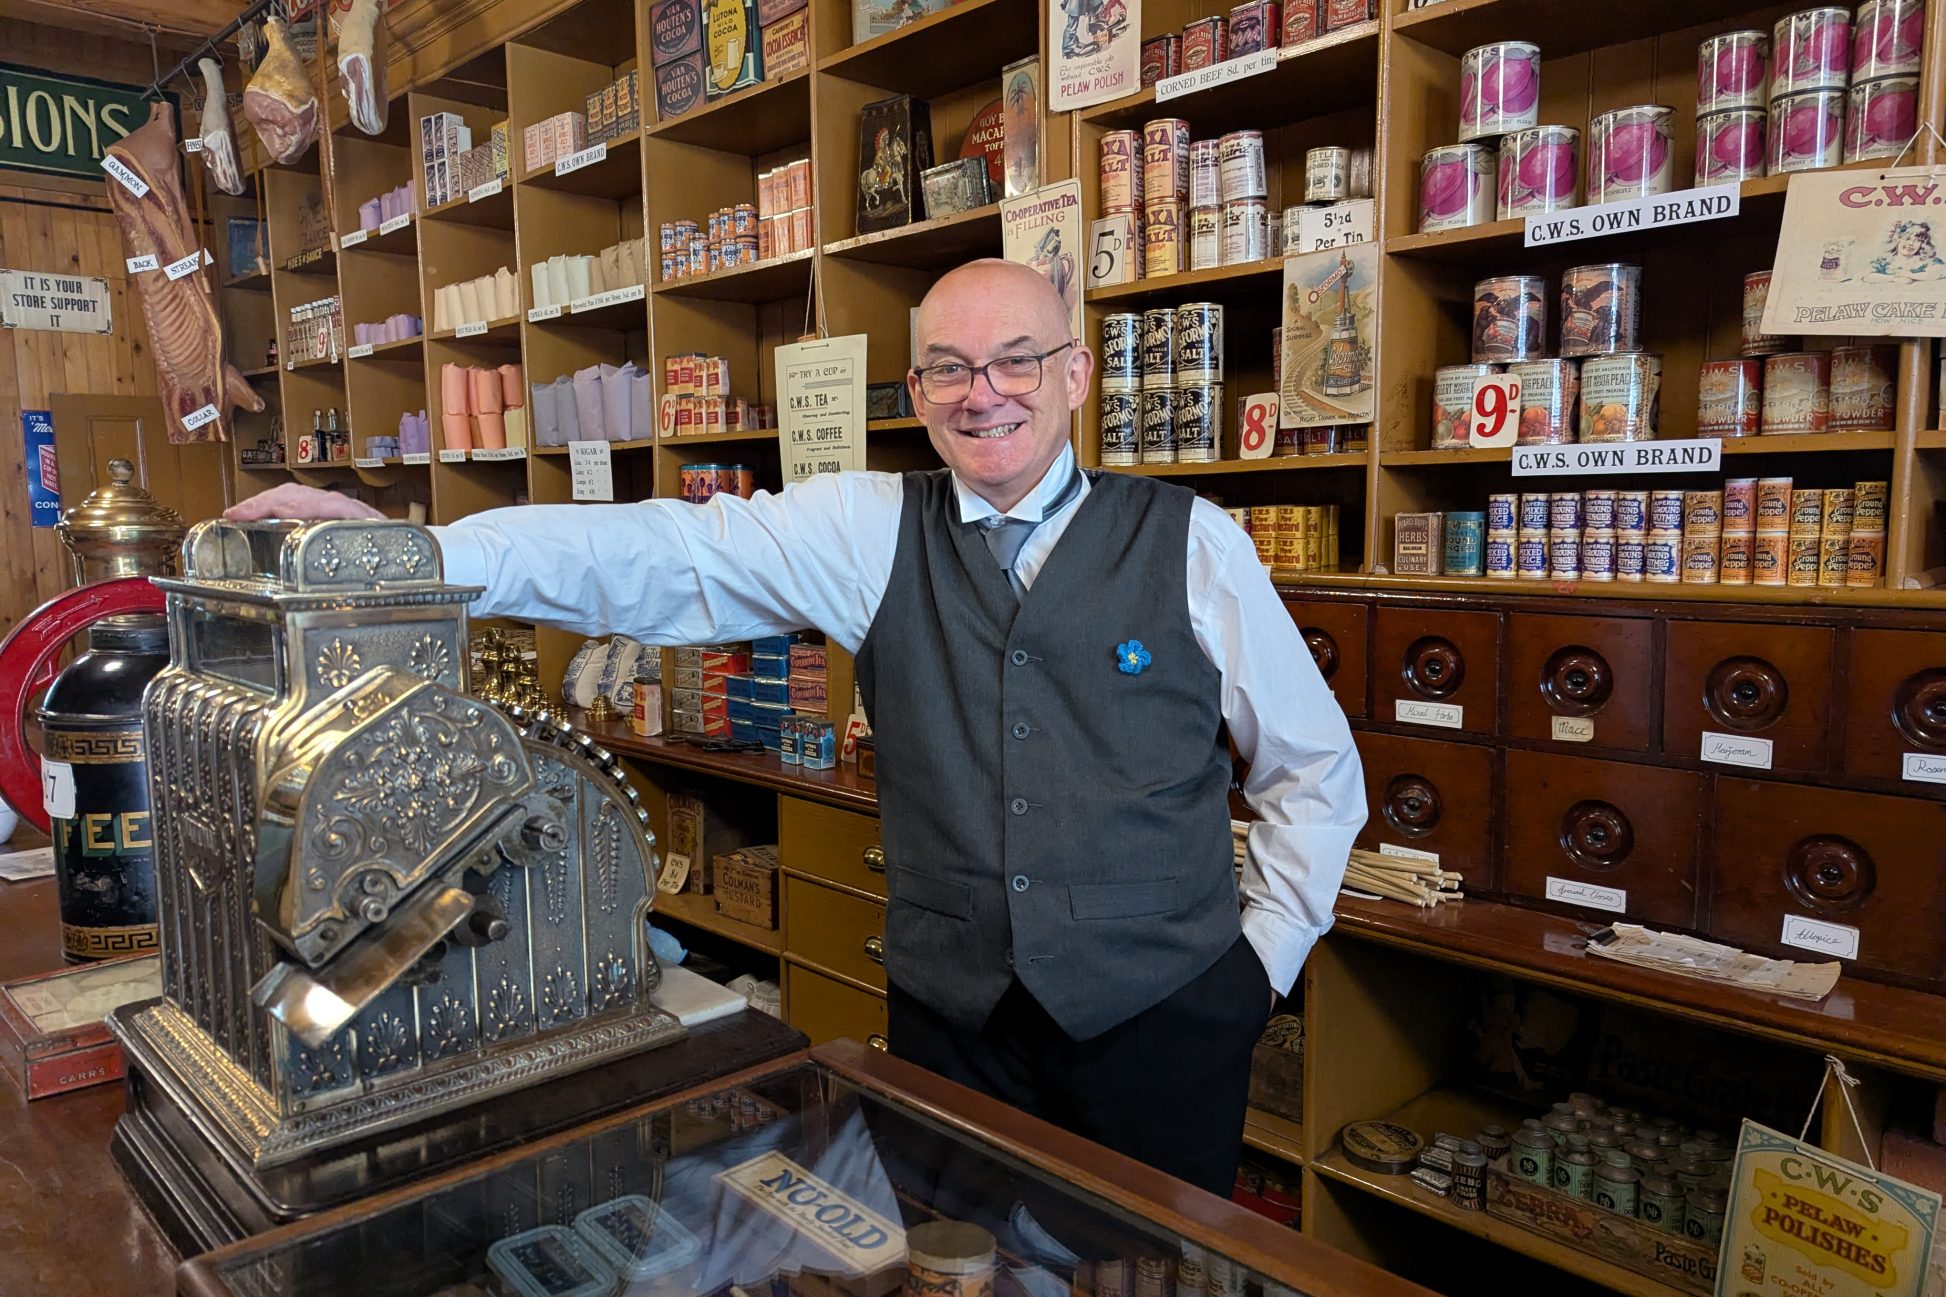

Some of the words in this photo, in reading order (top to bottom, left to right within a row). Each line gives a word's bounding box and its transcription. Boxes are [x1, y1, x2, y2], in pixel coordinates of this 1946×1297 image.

[667, 2, 680, 16] VAN
[713, 7, 738, 23] LUTONA
[656, 9, 691, 35] HOUTEN'S
[661, 26, 686, 43] COCOA
[713, 24, 738, 39] COCOA
[670, 65, 685, 78] VAN
[1160, 75, 1196, 96] CORNED
[1200, 68, 1223, 85] BEEF
[1243, 60, 1257, 75] per
[661, 71, 697, 96] HOUTEN'S
[1061, 80, 1091, 98] PELAW
[1094, 71, 1124, 91] POLISH
[667, 89, 692, 104] COCOA
[0, 84, 130, 161] IONS
[1144, 128, 1172, 147] AXA
[586, 148, 605, 162] BRAND
[1101, 139, 1129, 156] AXA
[1144, 149, 1172, 165] ALT
[1101, 159, 1130, 175] ALT
[107, 159, 144, 194] GAMMON
[1060, 194, 1078, 208] TEA
[1838, 184, 1946, 208] C.W.
[1015, 211, 1066, 240] FILLING
[1146, 208, 1178, 227] AXA
[1531, 223, 1584, 243] C.W.S.
[1591, 208, 1642, 232] OWN
[1651, 195, 1732, 226] BRAND
[1145, 228, 1176, 244] ALT
[1315, 237, 1336, 250] Per
[1343, 231, 1363, 244] Tin
[307, 248, 323, 263] SAUCE
[133, 259, 153, 270] BACK
[170, 257, 200, 276] STREAK
[24, 277, 35, 290] IT
[40, 278, 51, 291] IS
[53, 279, 83, 294] YOUR
[12, 294, 46, 308] STORE
[50, 297, 98, 313] SUPPORT
[50, 314, 61, 328] IT
[1793, 302, 1870, 323] PELAW
[1871, 302, 1937, 318] CAKE
[800, 369, 812, 379] TRY
[815, 368, 821, 377] A
[823, 366, 838, 377] CUP
[790, 395, 812, 409] C.W.S.
[815, 393, 828, 407] TEA
[187, 409, 215, 427] COLLAR
[792, 429, 814, 443] C.W.S.
[816, 426, 842, 440] COFFEE
[1518, 453, 1570, 471] C.W.S.
[1577, 449, 1625, 467] OWN
[1635, 446, 1713, 466] BRAND
[794, 462, 815, 475] C.W.S.
[818, 461, 841, 474] COCOA
[1523, 514, 1549, 522] SPICE
[1653, 514, 1681, 522] NUTMEG
[1688, 515, 1717, 524] Pepper
[1690, 508, 1715, 517] Ground
[1855, 507, 1885, 517] Pepper
[1399, 531, 1428, 543] HERBS
[1686, 560, 1714, 570] Pepper
[1687, 554, 1713, 562] Ground
[722, 871, 761, 895] COLMAN'S
[722, 885, 762, 909] MUSTARD
[59, 1066, 106, 1086] CARR'S
[1784, 1193, 1866, 1240] PELAW
[1762, 1206, 1887, 1275] POLISHES
[1653, 1240, 1697, 1277] Paste
[1795, 1265, 1818, 1281] Sold
[1803, 1279, 1825, 1296] ALL
